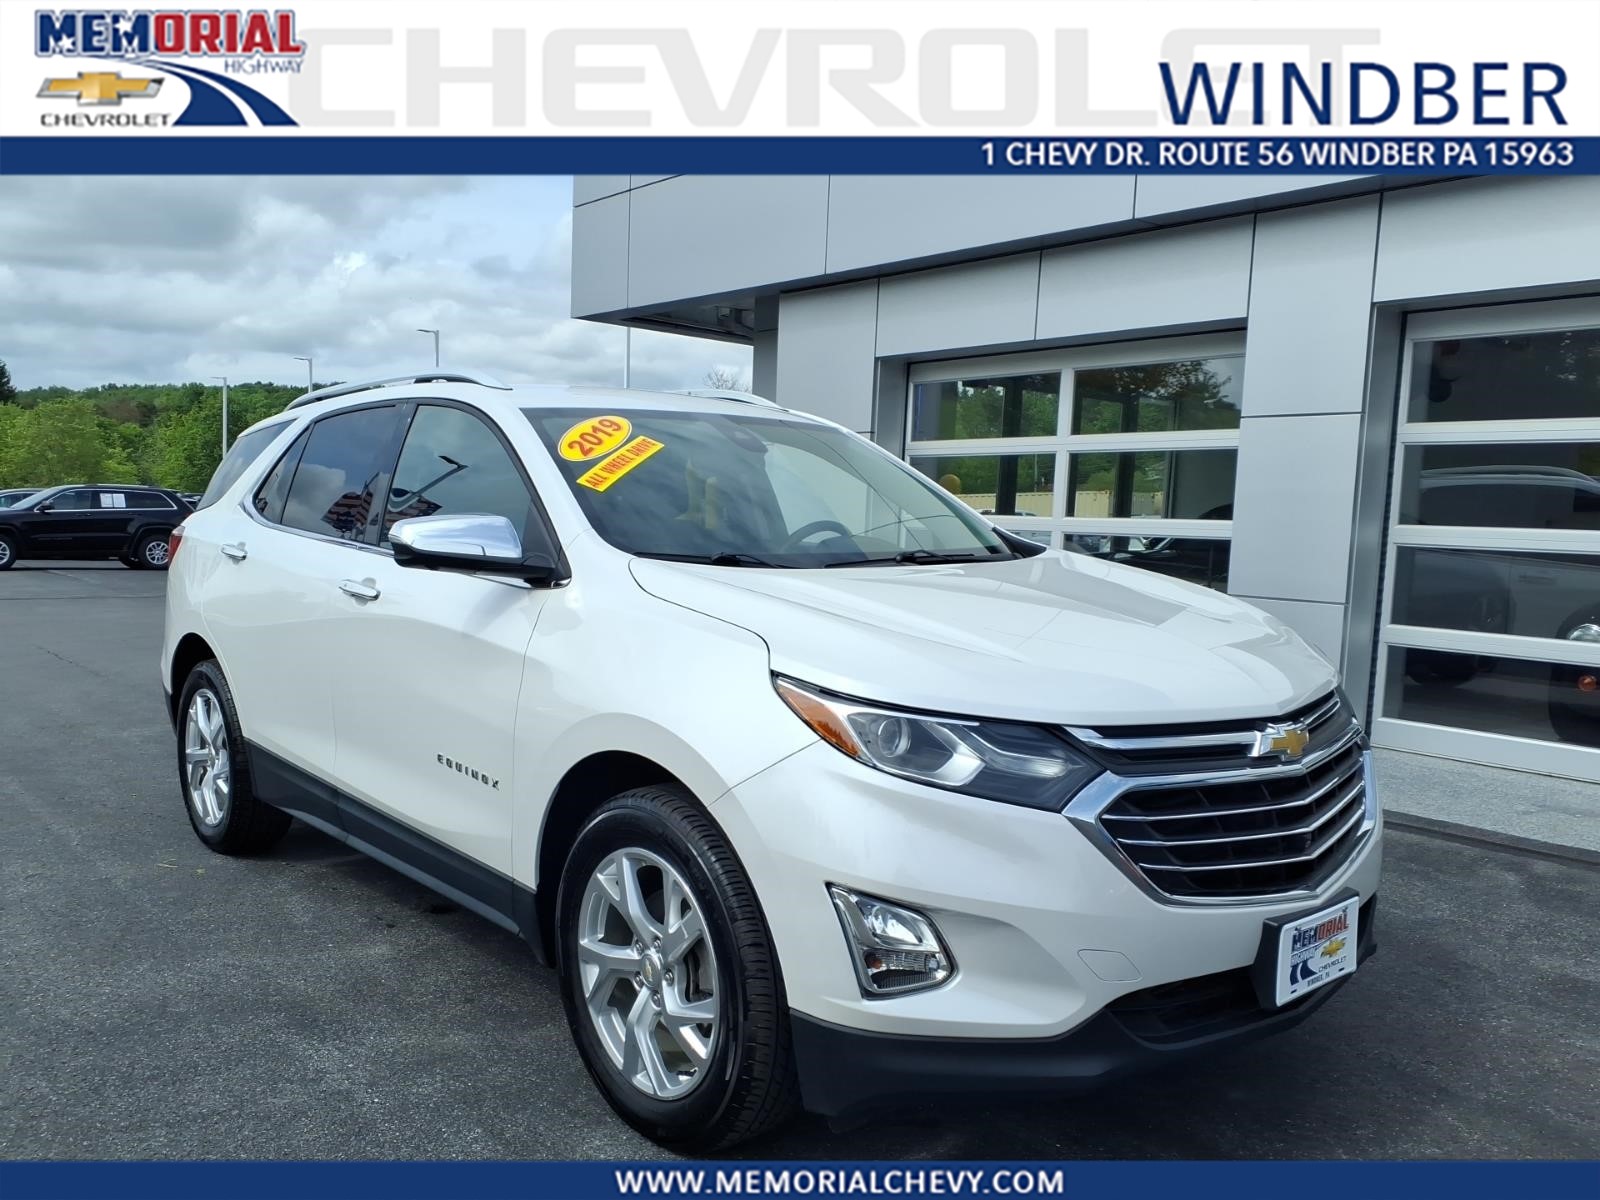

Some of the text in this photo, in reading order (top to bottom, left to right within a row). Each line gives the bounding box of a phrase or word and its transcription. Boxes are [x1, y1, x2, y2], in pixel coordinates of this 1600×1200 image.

[567, 418, 622, 456] 2019
[585, 438, 658, 487] ALL WHEEL DRIVE
[437, 753, 500, 791] EQUINOX
[1291, 911, 1350, 953] MEMORIAL
[1318, 956, 1347, 972] CHEVROLET
